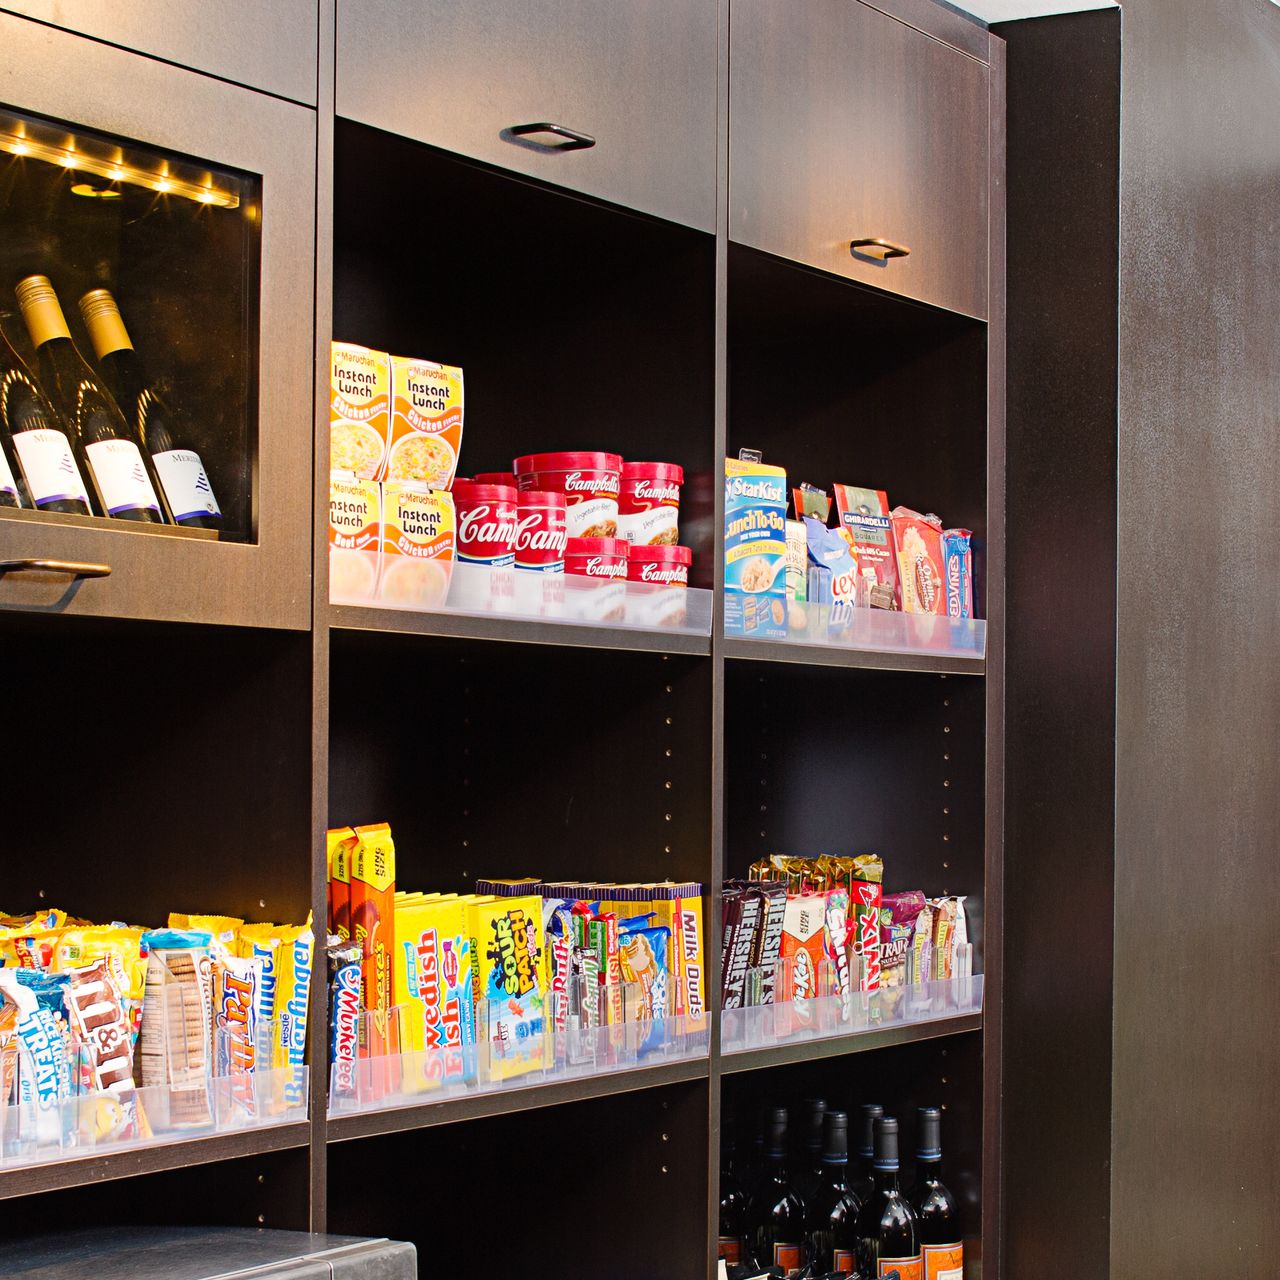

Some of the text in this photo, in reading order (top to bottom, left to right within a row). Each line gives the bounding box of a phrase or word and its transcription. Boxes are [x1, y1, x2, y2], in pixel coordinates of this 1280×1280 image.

[340, 350, 375, 367] Maruchan
[334, 365, 377, 386] Instant
[414, 366, 449, 381] Maruchan
[337, 380, 373, 398] Lunch
[407, 379, 451, 399] Instant
[332, 396, 370, 419] Chicken
[412, 393, 446, 412] Lunch
[407, 408, 443, 432] Chicken
[405, 492, 439, 507] Maruchan
[733, 478, 783, 502] StarKist
[330, 512, 363, 528] Lunch
[398, 506, 442, 524] Instant
[844, 513, 889, 527] GHIRARDELLI
[402, 520, 437, 537] Lunch
[334, 532, 356, 549] Beef
[398, 535, 434, 558] Chicken
[504, 918, 519, 996] SOUR
[518, 909, 534, 996] PATCH
[725, 899, 760, 1010] HERSHEY'S
[761, 894, 787, 1006] HERSHEY'S
[417, 928, 444, 1081] Swedish
[37, 1008, 59, 1040] RICE
[441, 998, 463, 1078] Fish
[18, 1010, 55, 1111] TREATS
